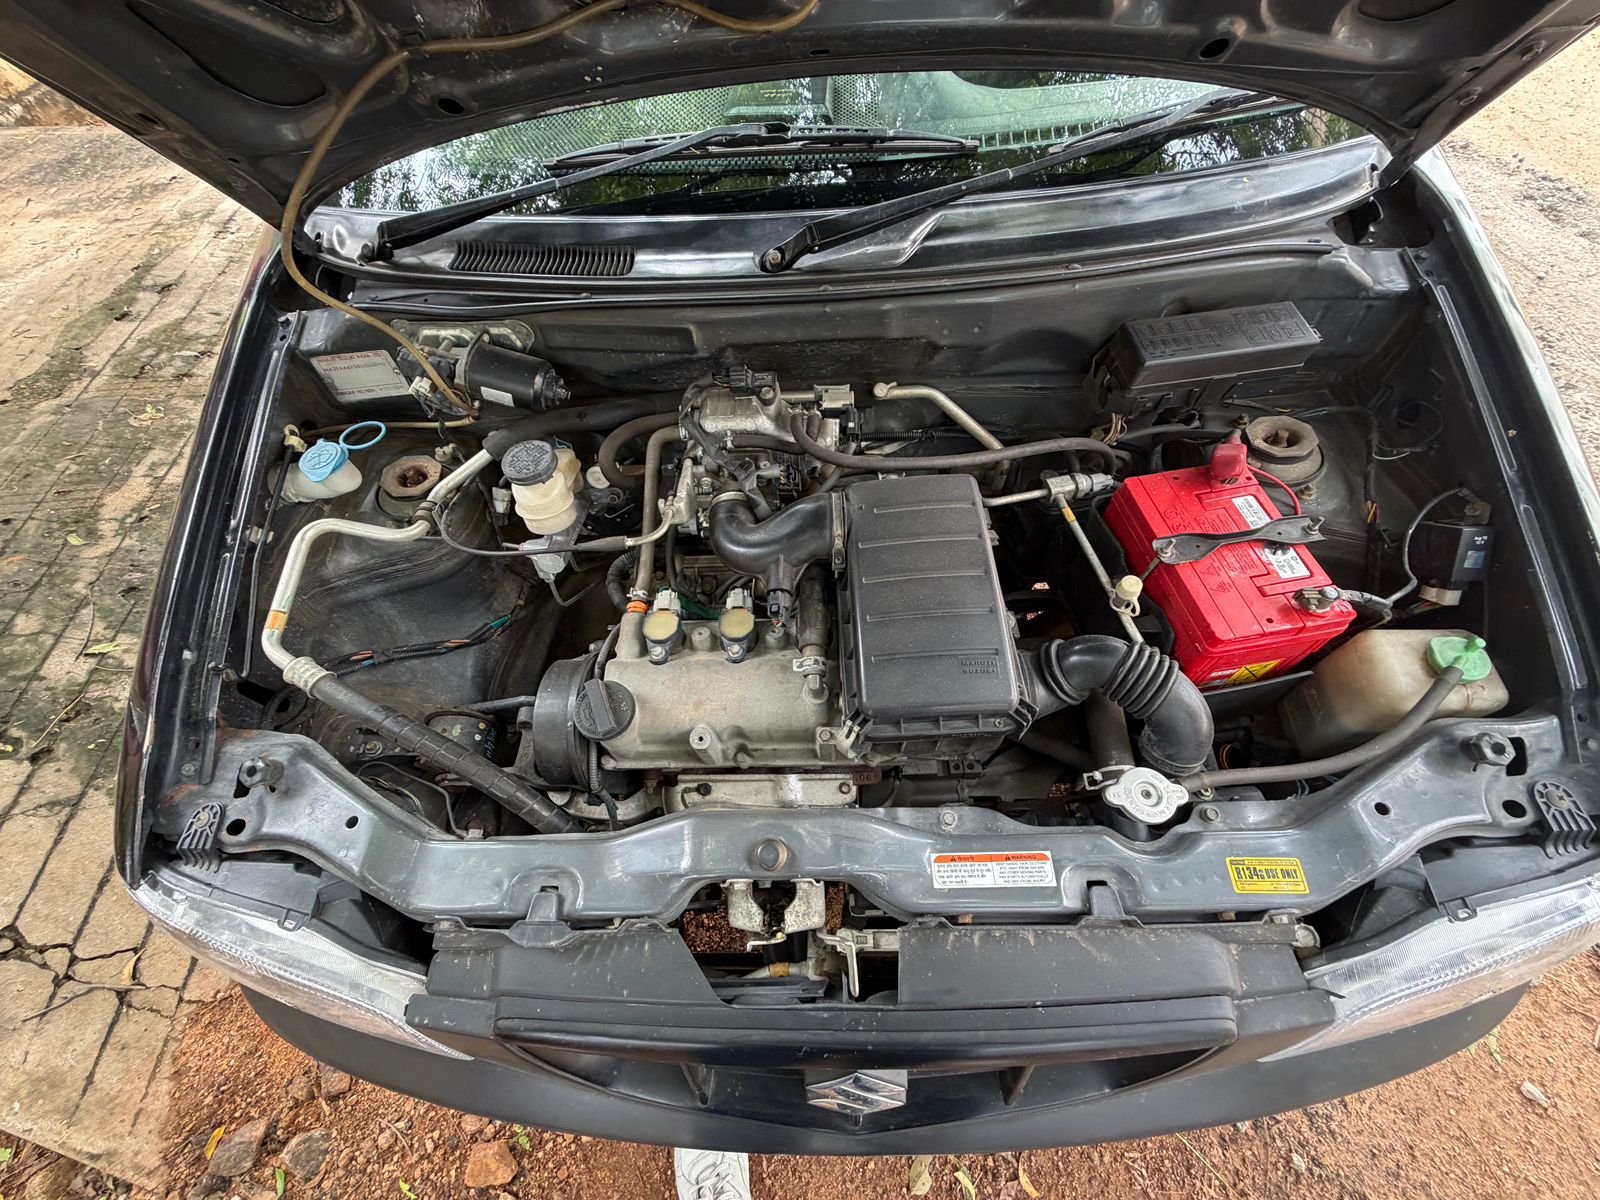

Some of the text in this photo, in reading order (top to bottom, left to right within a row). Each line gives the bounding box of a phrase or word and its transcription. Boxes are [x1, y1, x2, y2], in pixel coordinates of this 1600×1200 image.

[1145, 807, 1167, 818] NEVER
[1265, 868, 1281, 880] USE
[1280, 868, 1299, 880] ONLY
